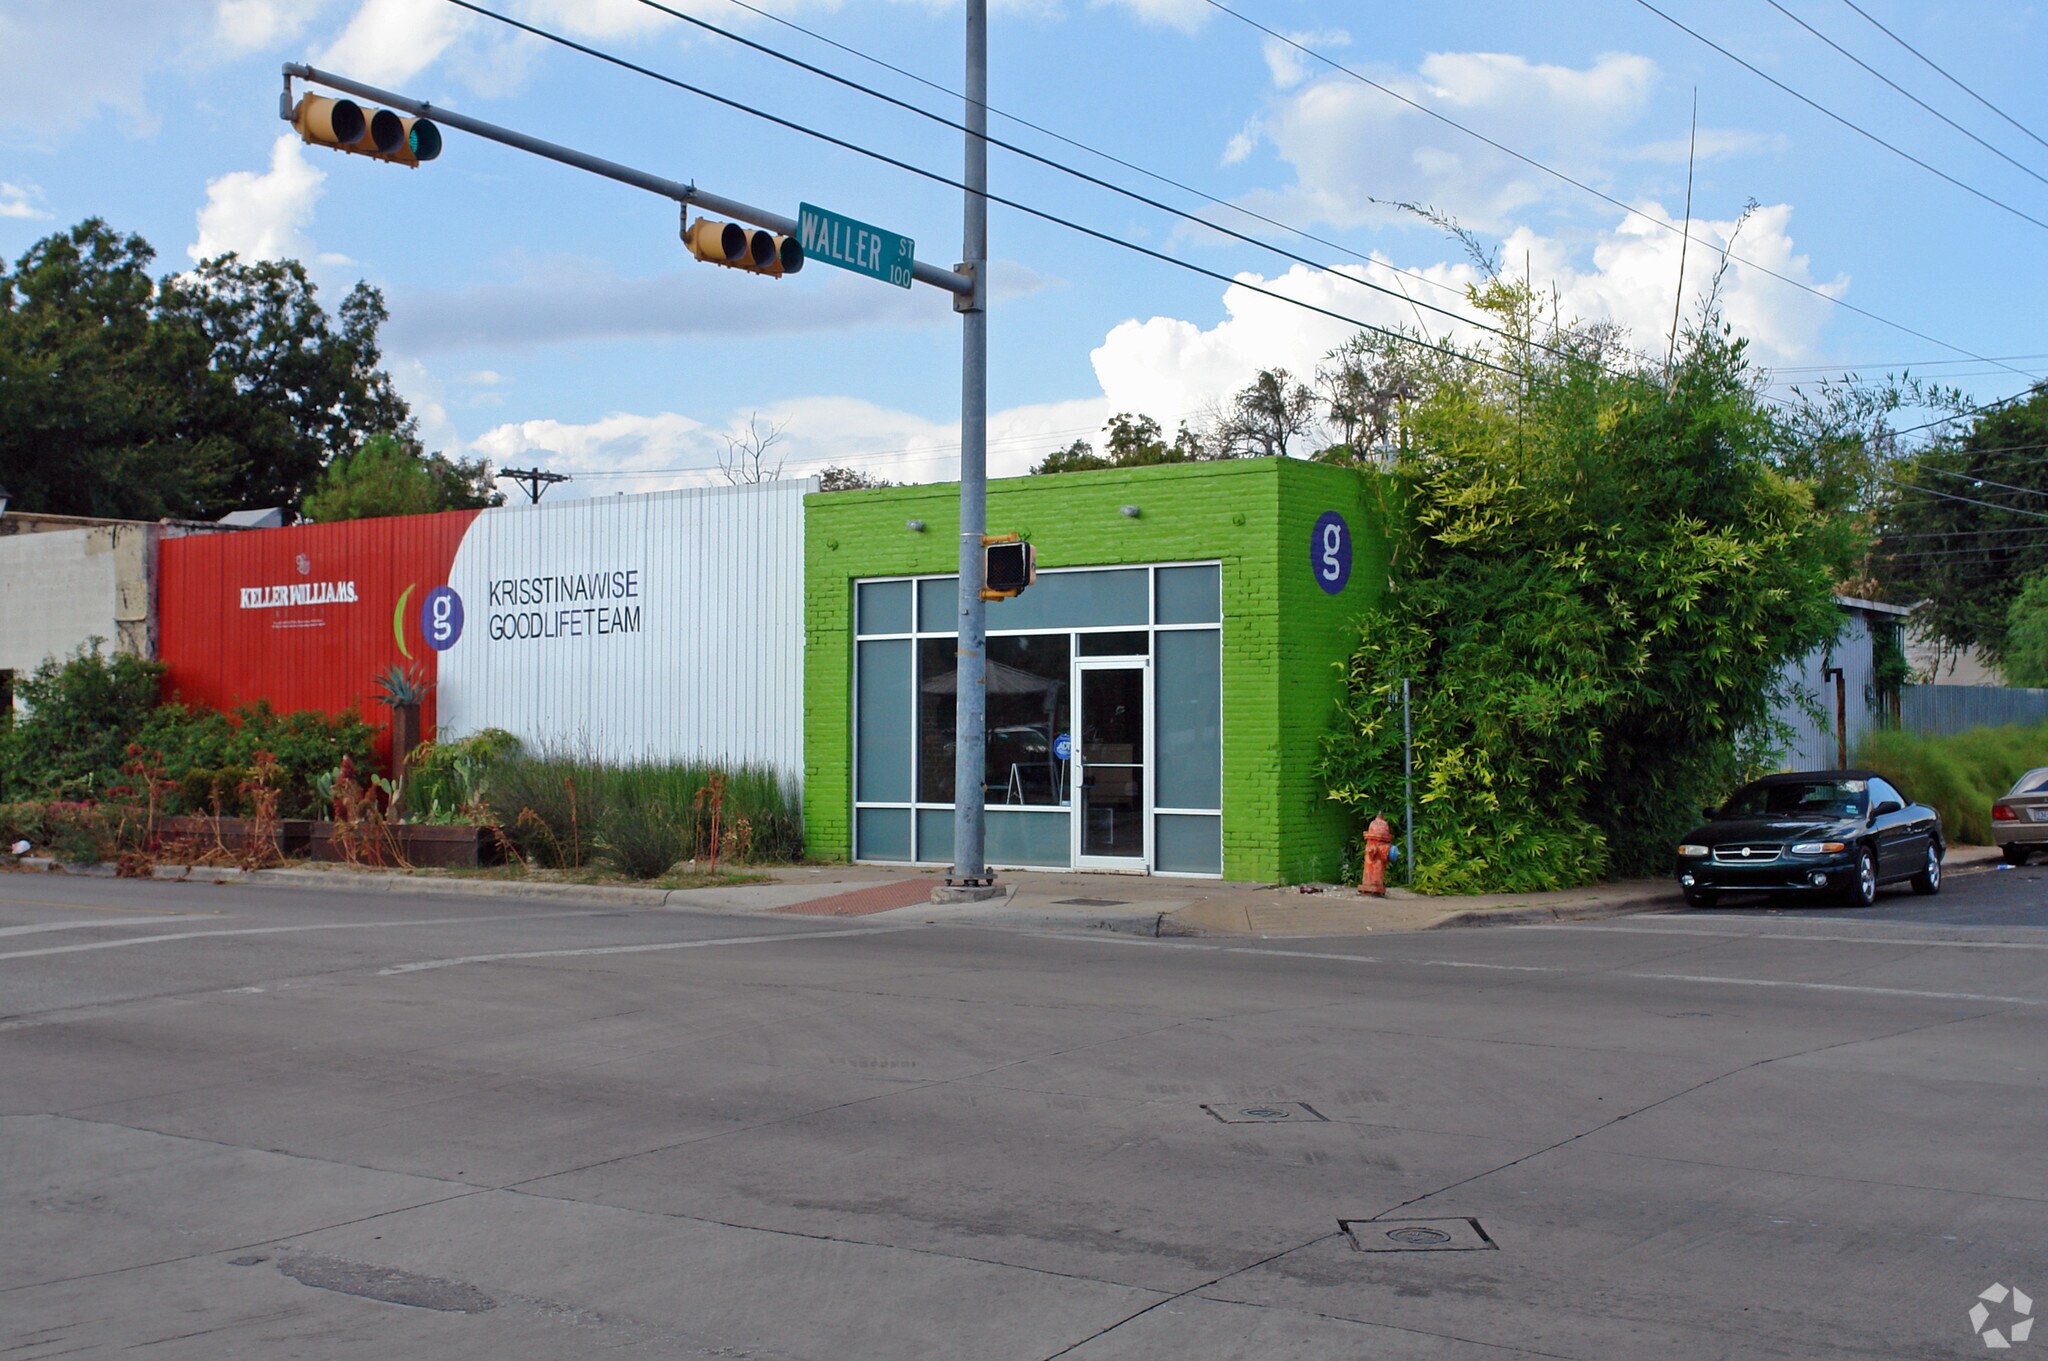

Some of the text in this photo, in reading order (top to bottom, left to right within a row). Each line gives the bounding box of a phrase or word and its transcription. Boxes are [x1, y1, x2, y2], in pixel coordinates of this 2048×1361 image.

[801, 210, 882, 272] WALLER
[899, 238, 914, 259] ST
[889, 264, 911, 288] 100
[1323, 523, 1341, 581] g
[240, 585, 289, 609] KELLER
[433, 594, 452, 641] g
